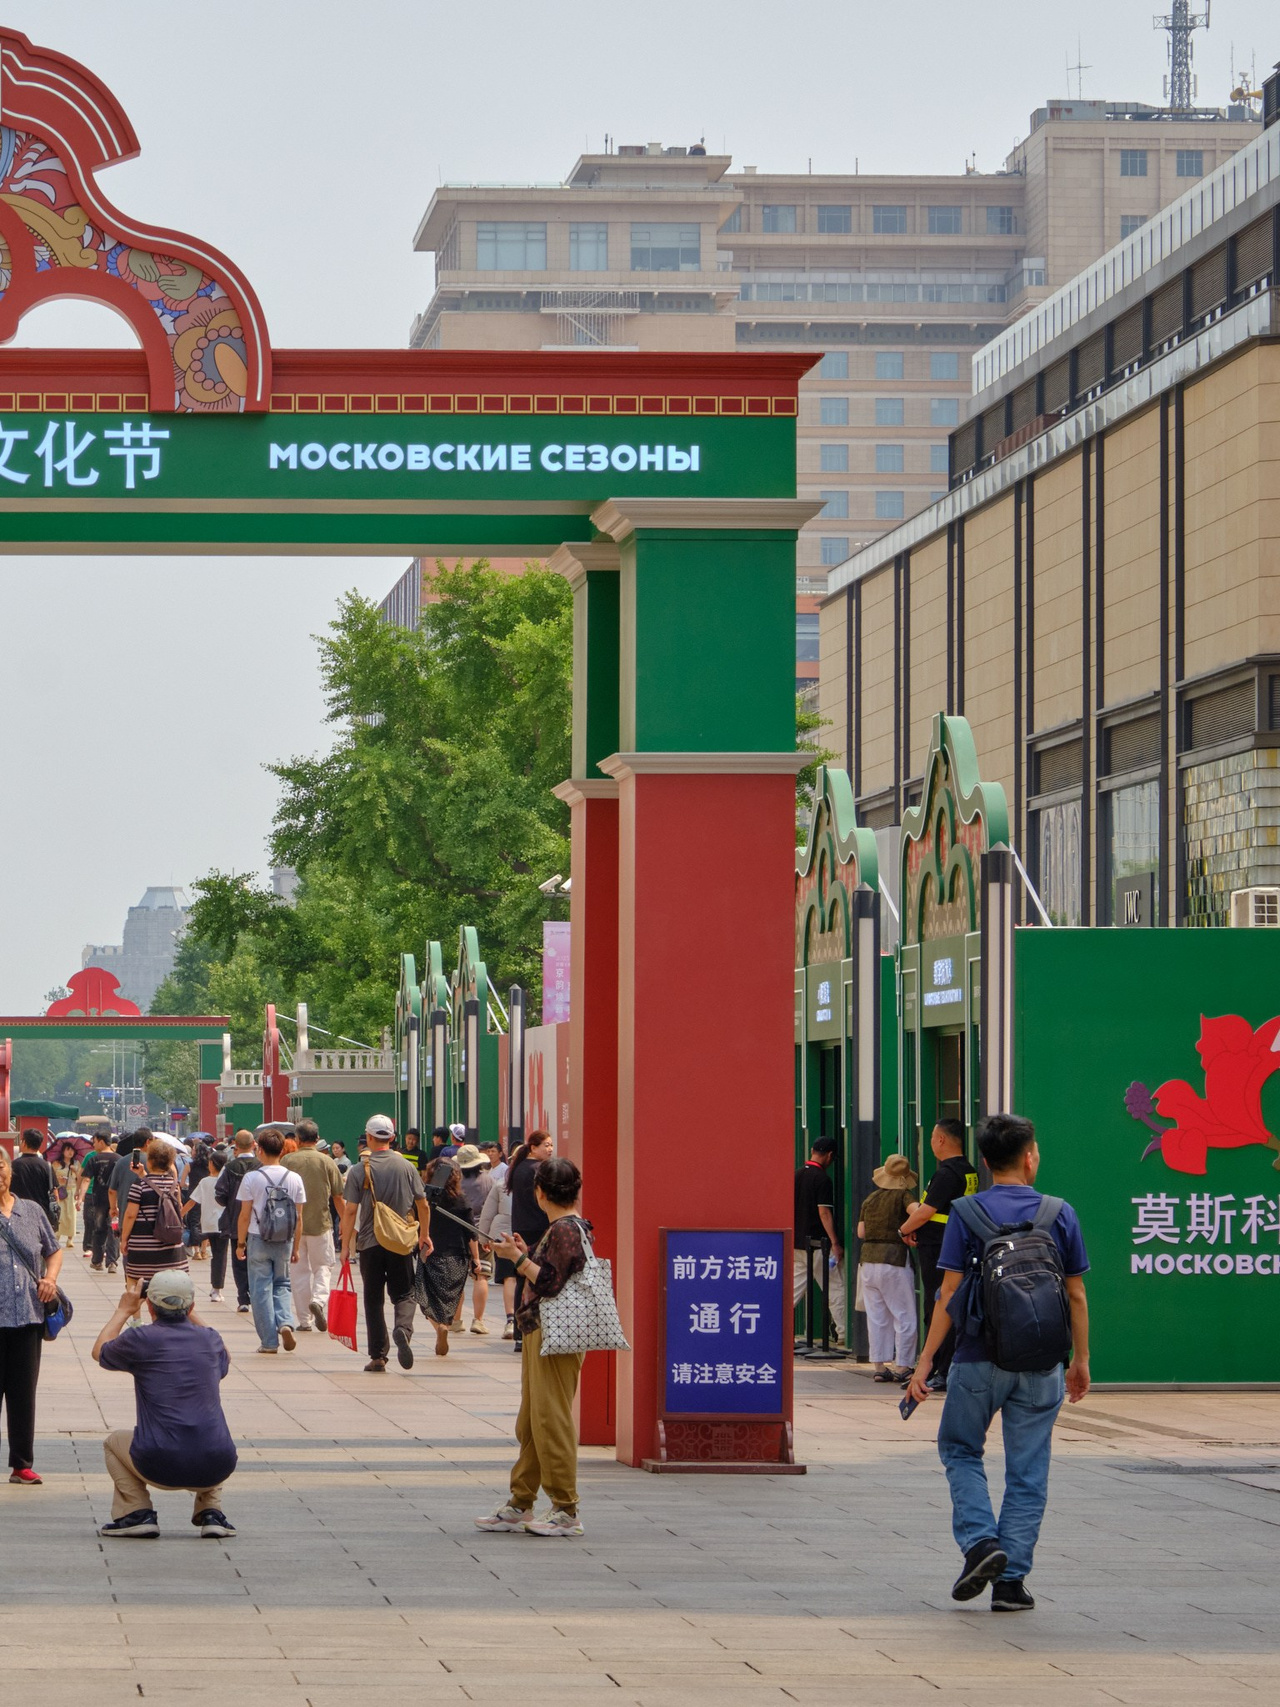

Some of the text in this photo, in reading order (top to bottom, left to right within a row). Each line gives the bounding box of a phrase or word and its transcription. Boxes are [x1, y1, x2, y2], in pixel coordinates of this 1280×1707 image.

[269, 442, 700, 472] МОСКОВСКИЕ СЕЗОНЫ
[1124, 889, 1140, 925] IWC
[1131, 1193, 1280, 1245] 莫斯科
[672, 1255, 778, 1280] 前方活动
[689, 1302, 761, 1334] 通行
[671, 1363, 777, 1385] 请注意安全
